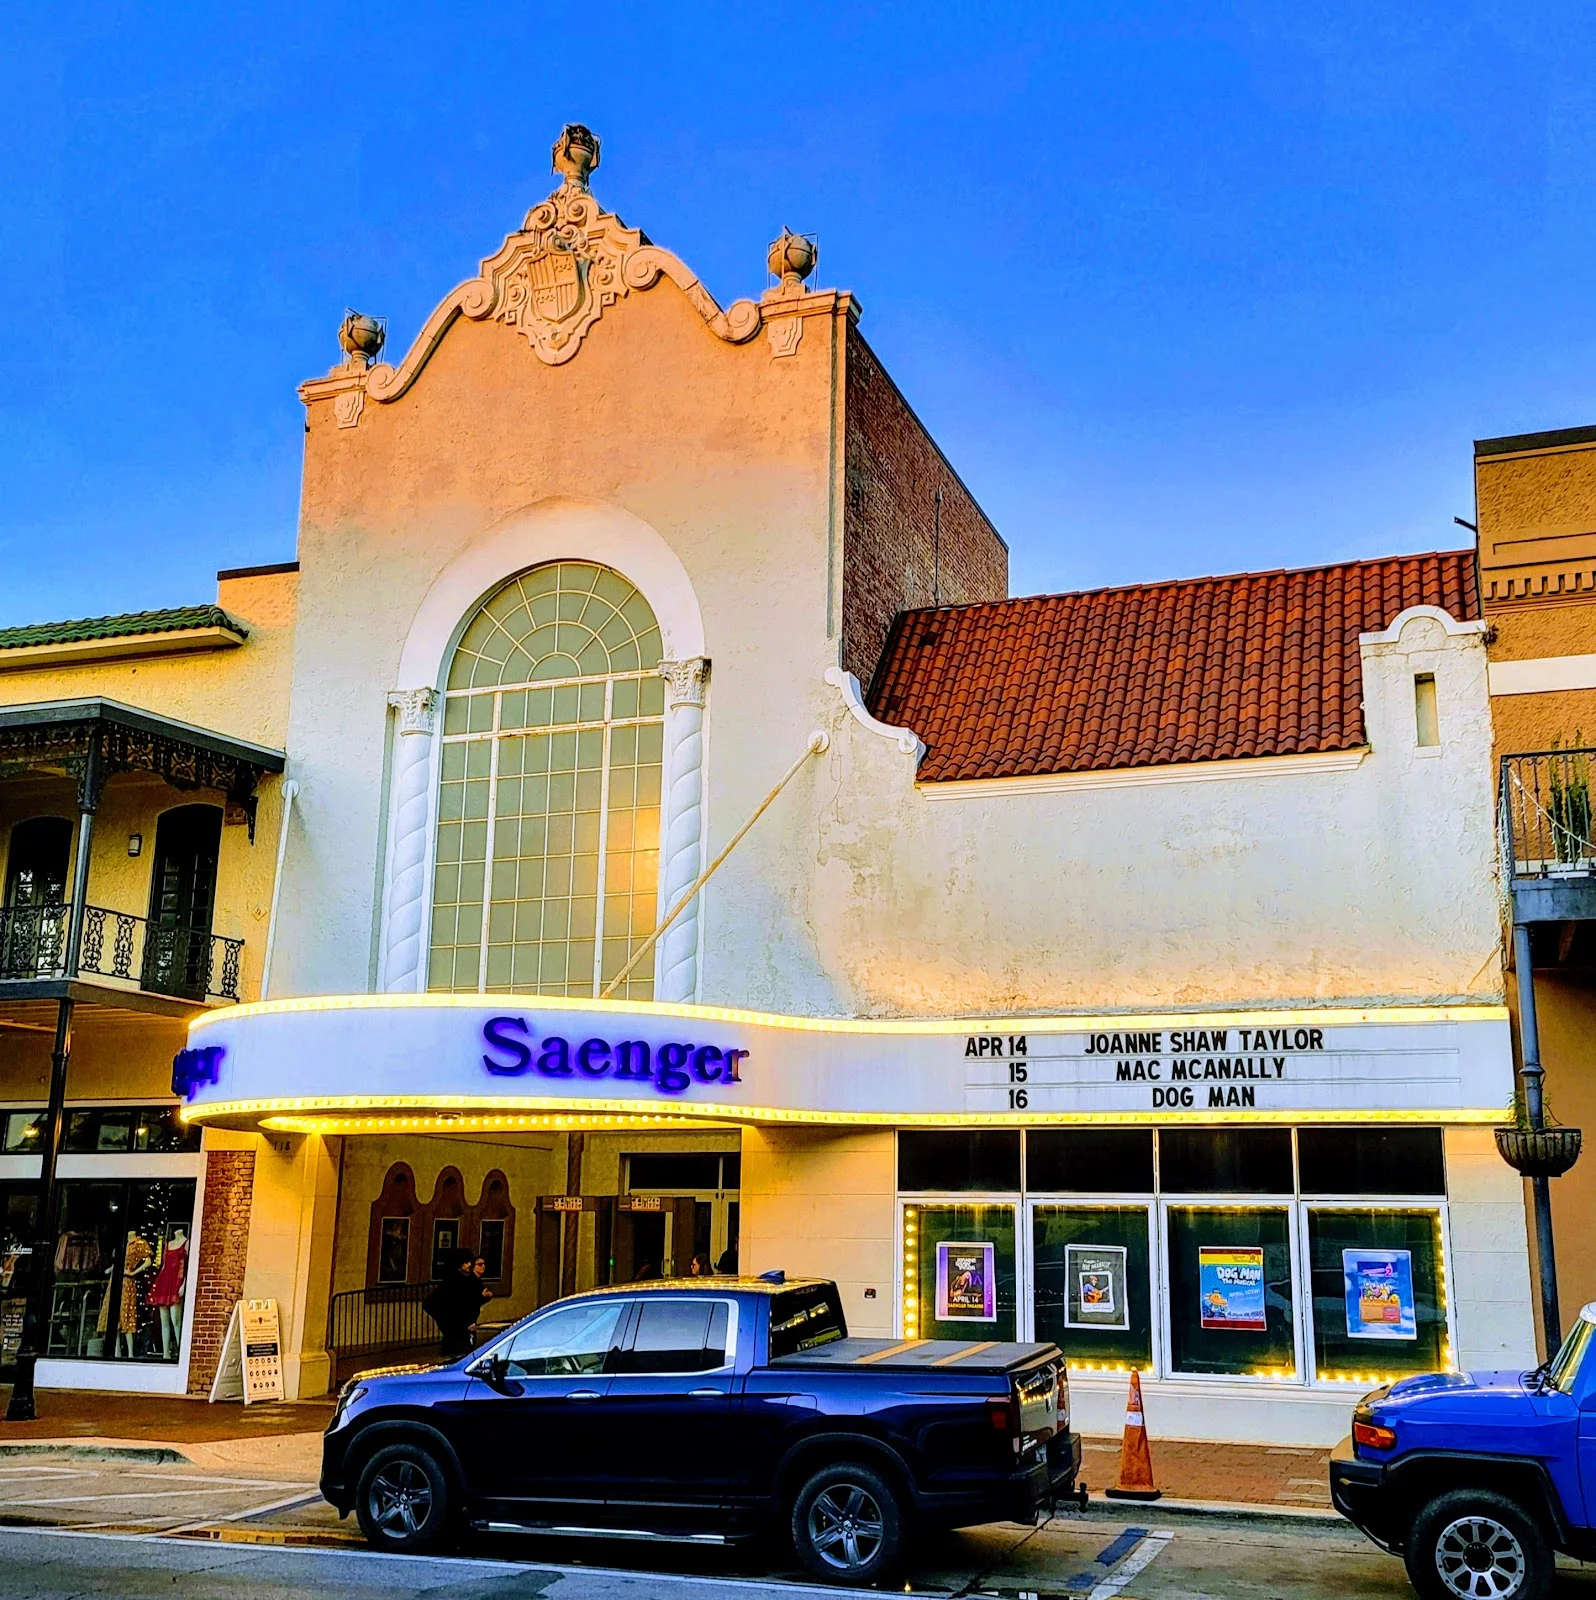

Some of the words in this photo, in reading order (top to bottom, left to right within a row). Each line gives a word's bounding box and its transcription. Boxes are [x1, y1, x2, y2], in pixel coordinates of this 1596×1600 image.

[965, 1037, 1003, 1056] APR
[1008, 1035, 1027, 1056] 14
[1085, 1033, 1162, 1054] JOANNE
[1170, 1031, 1227, 1053] SHAW
[1239, 1029, 1323, 1050] TAYLOR
[482, 1016, 750, 1091] Saenger
[1009, 1062, 1028, 1082] 15
[1116, 1060, 1161, 1081] MAC
[1171, 1057, 1285, 1080] MCANALLY
[1009, 1089, 1028, 1109] 16
[1152, 1086, 1194, 1108] DOG
[1208, 1086, 1255, 1107] MAN
[1216, 1266, 1238, 1280] DOG
[1240, 1267, 1261, 1280] MAN
